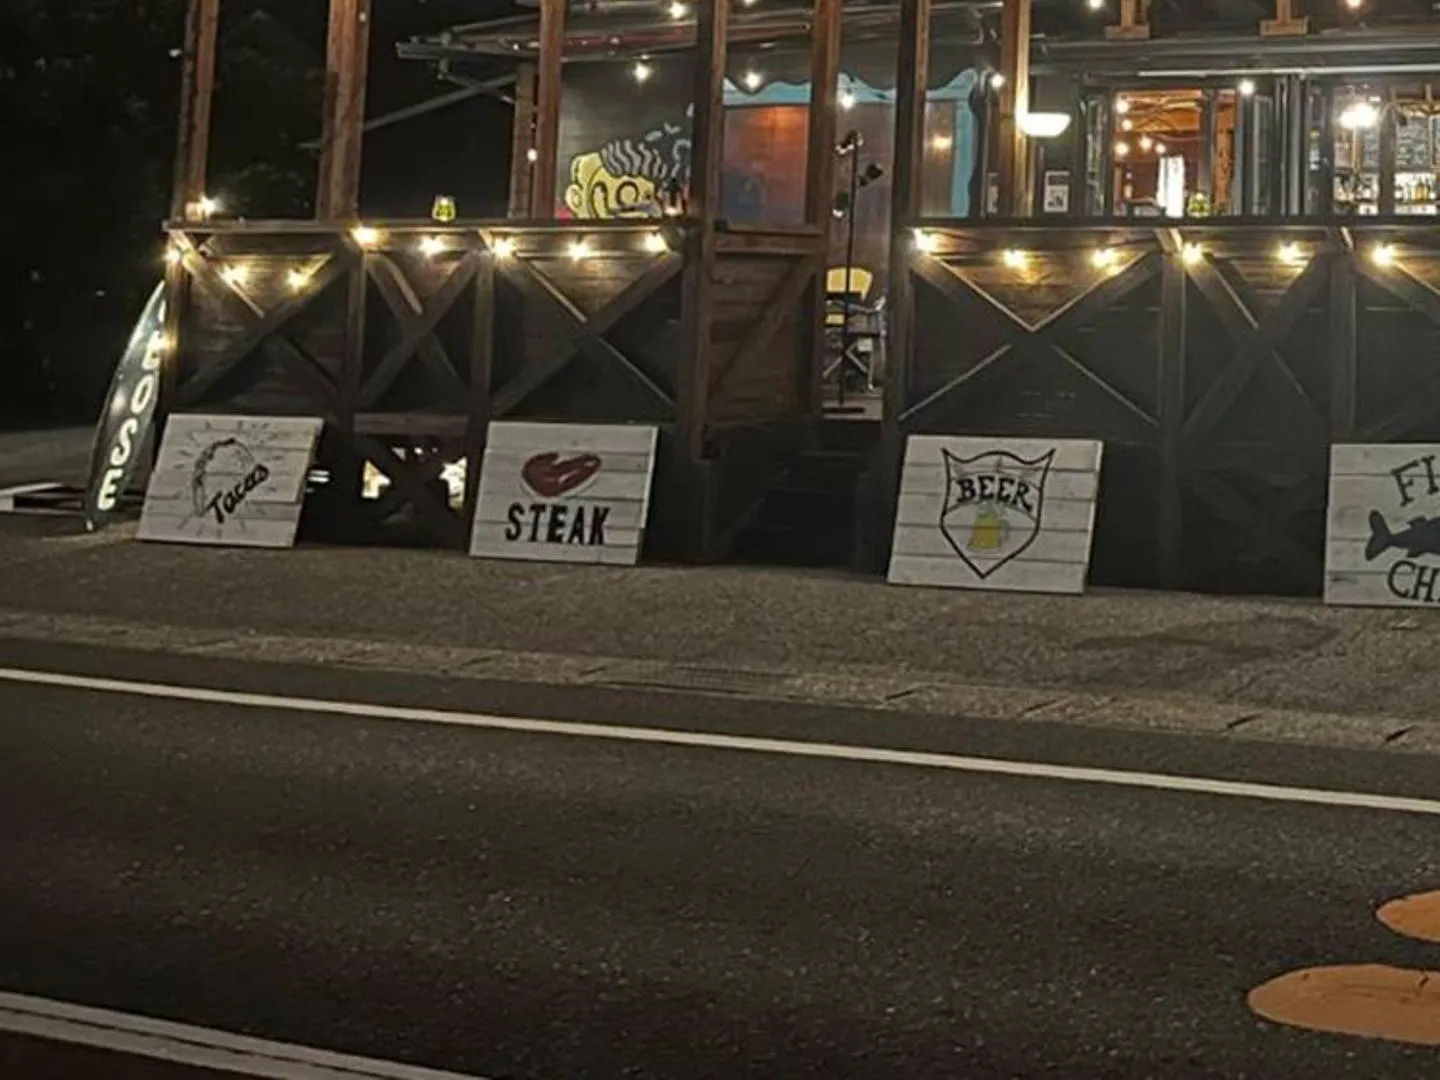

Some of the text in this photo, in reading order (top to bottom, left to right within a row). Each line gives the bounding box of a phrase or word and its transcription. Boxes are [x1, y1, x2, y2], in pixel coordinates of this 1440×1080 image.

[206, 463, 271, 524] Tacos
[956, 475, 1033, 512] BEER
[504, 502, 608, 547] STEAK
